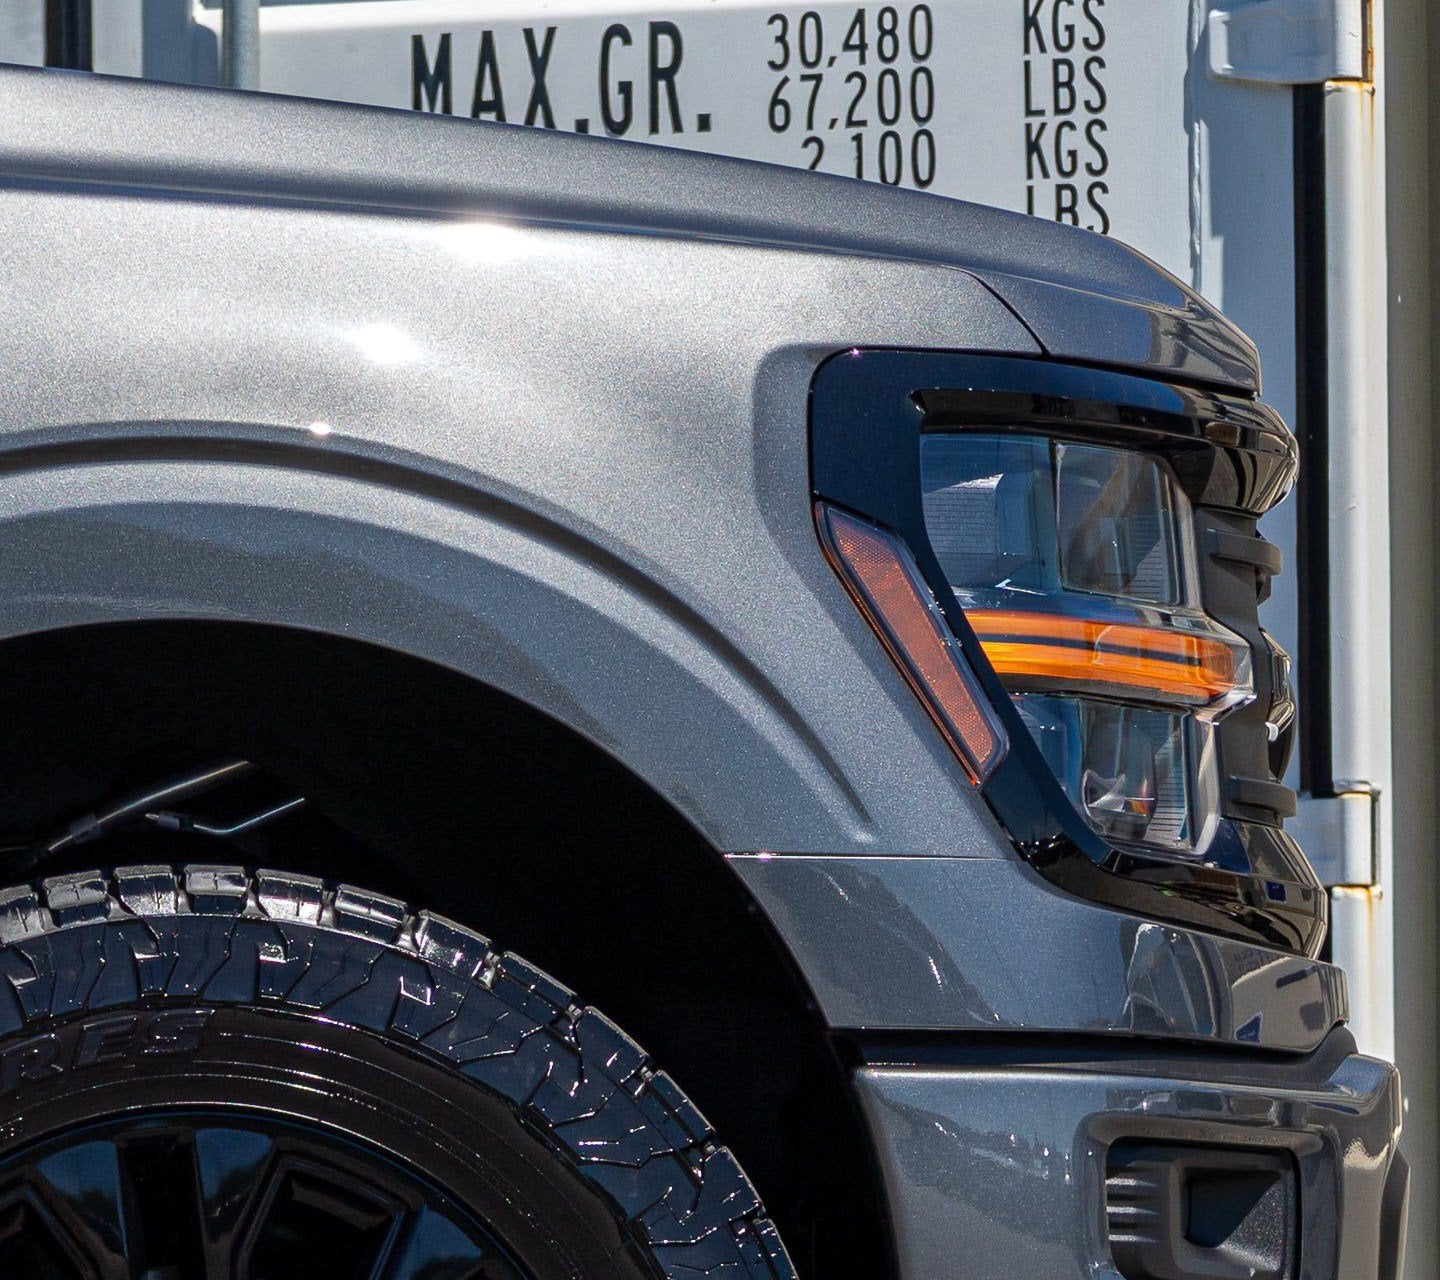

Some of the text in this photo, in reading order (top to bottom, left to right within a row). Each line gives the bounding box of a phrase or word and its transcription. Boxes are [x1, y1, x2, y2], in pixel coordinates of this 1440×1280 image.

[766, 4, 935, 72] 30,480
[767, 57, 1107, 134] 67,200 LBS
[1025, 119, 1110, 179] KGS
